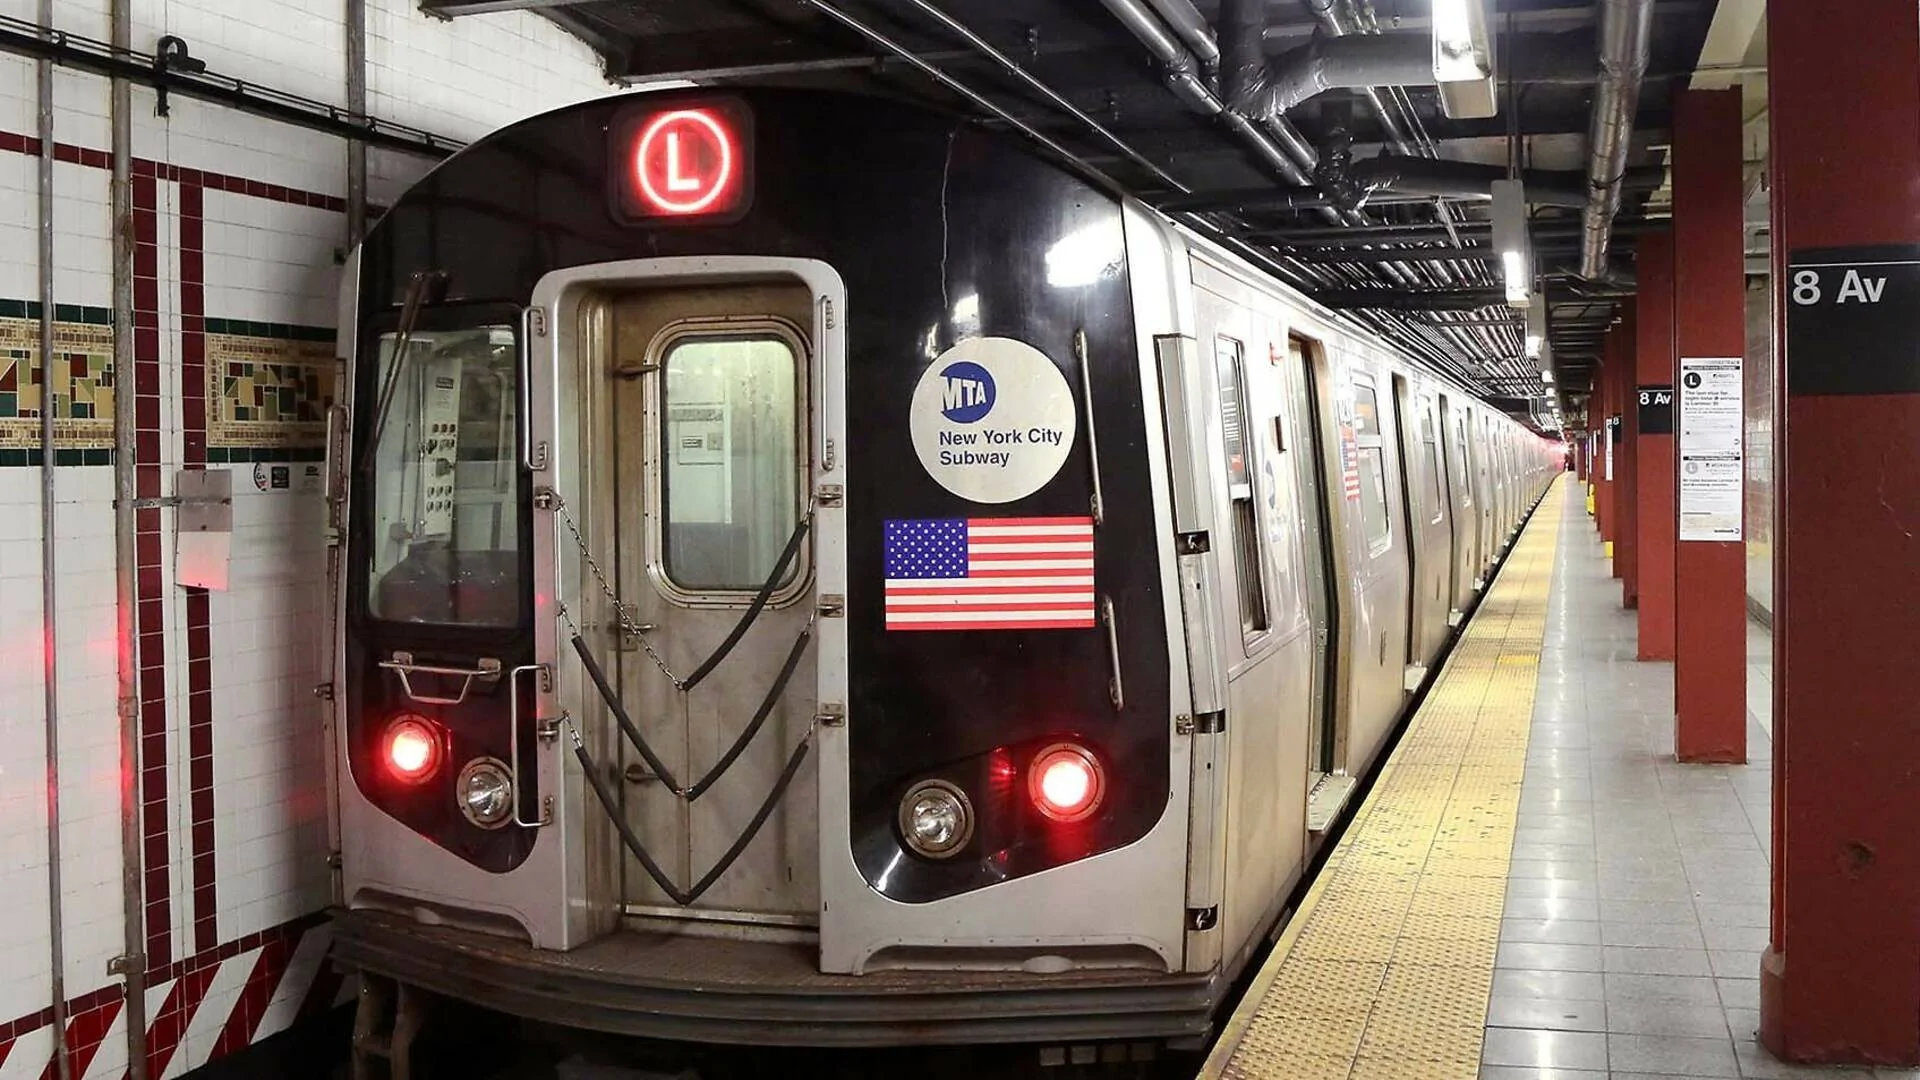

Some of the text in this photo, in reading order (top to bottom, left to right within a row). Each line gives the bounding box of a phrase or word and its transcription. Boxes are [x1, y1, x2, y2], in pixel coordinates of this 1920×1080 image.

[667, 131, 700, 191] L
[1792, 269, 1888, 305] 8 Av
[940, 375, 987, 412] MTA
[1639, 392, 1650, 406] 8
[1654, 392, 1672, 405] Av
[1612, 416, 1620, 426] 8
[939, 428, 1062, 446] New York City
[939, 449, 1010, 468] Subway
